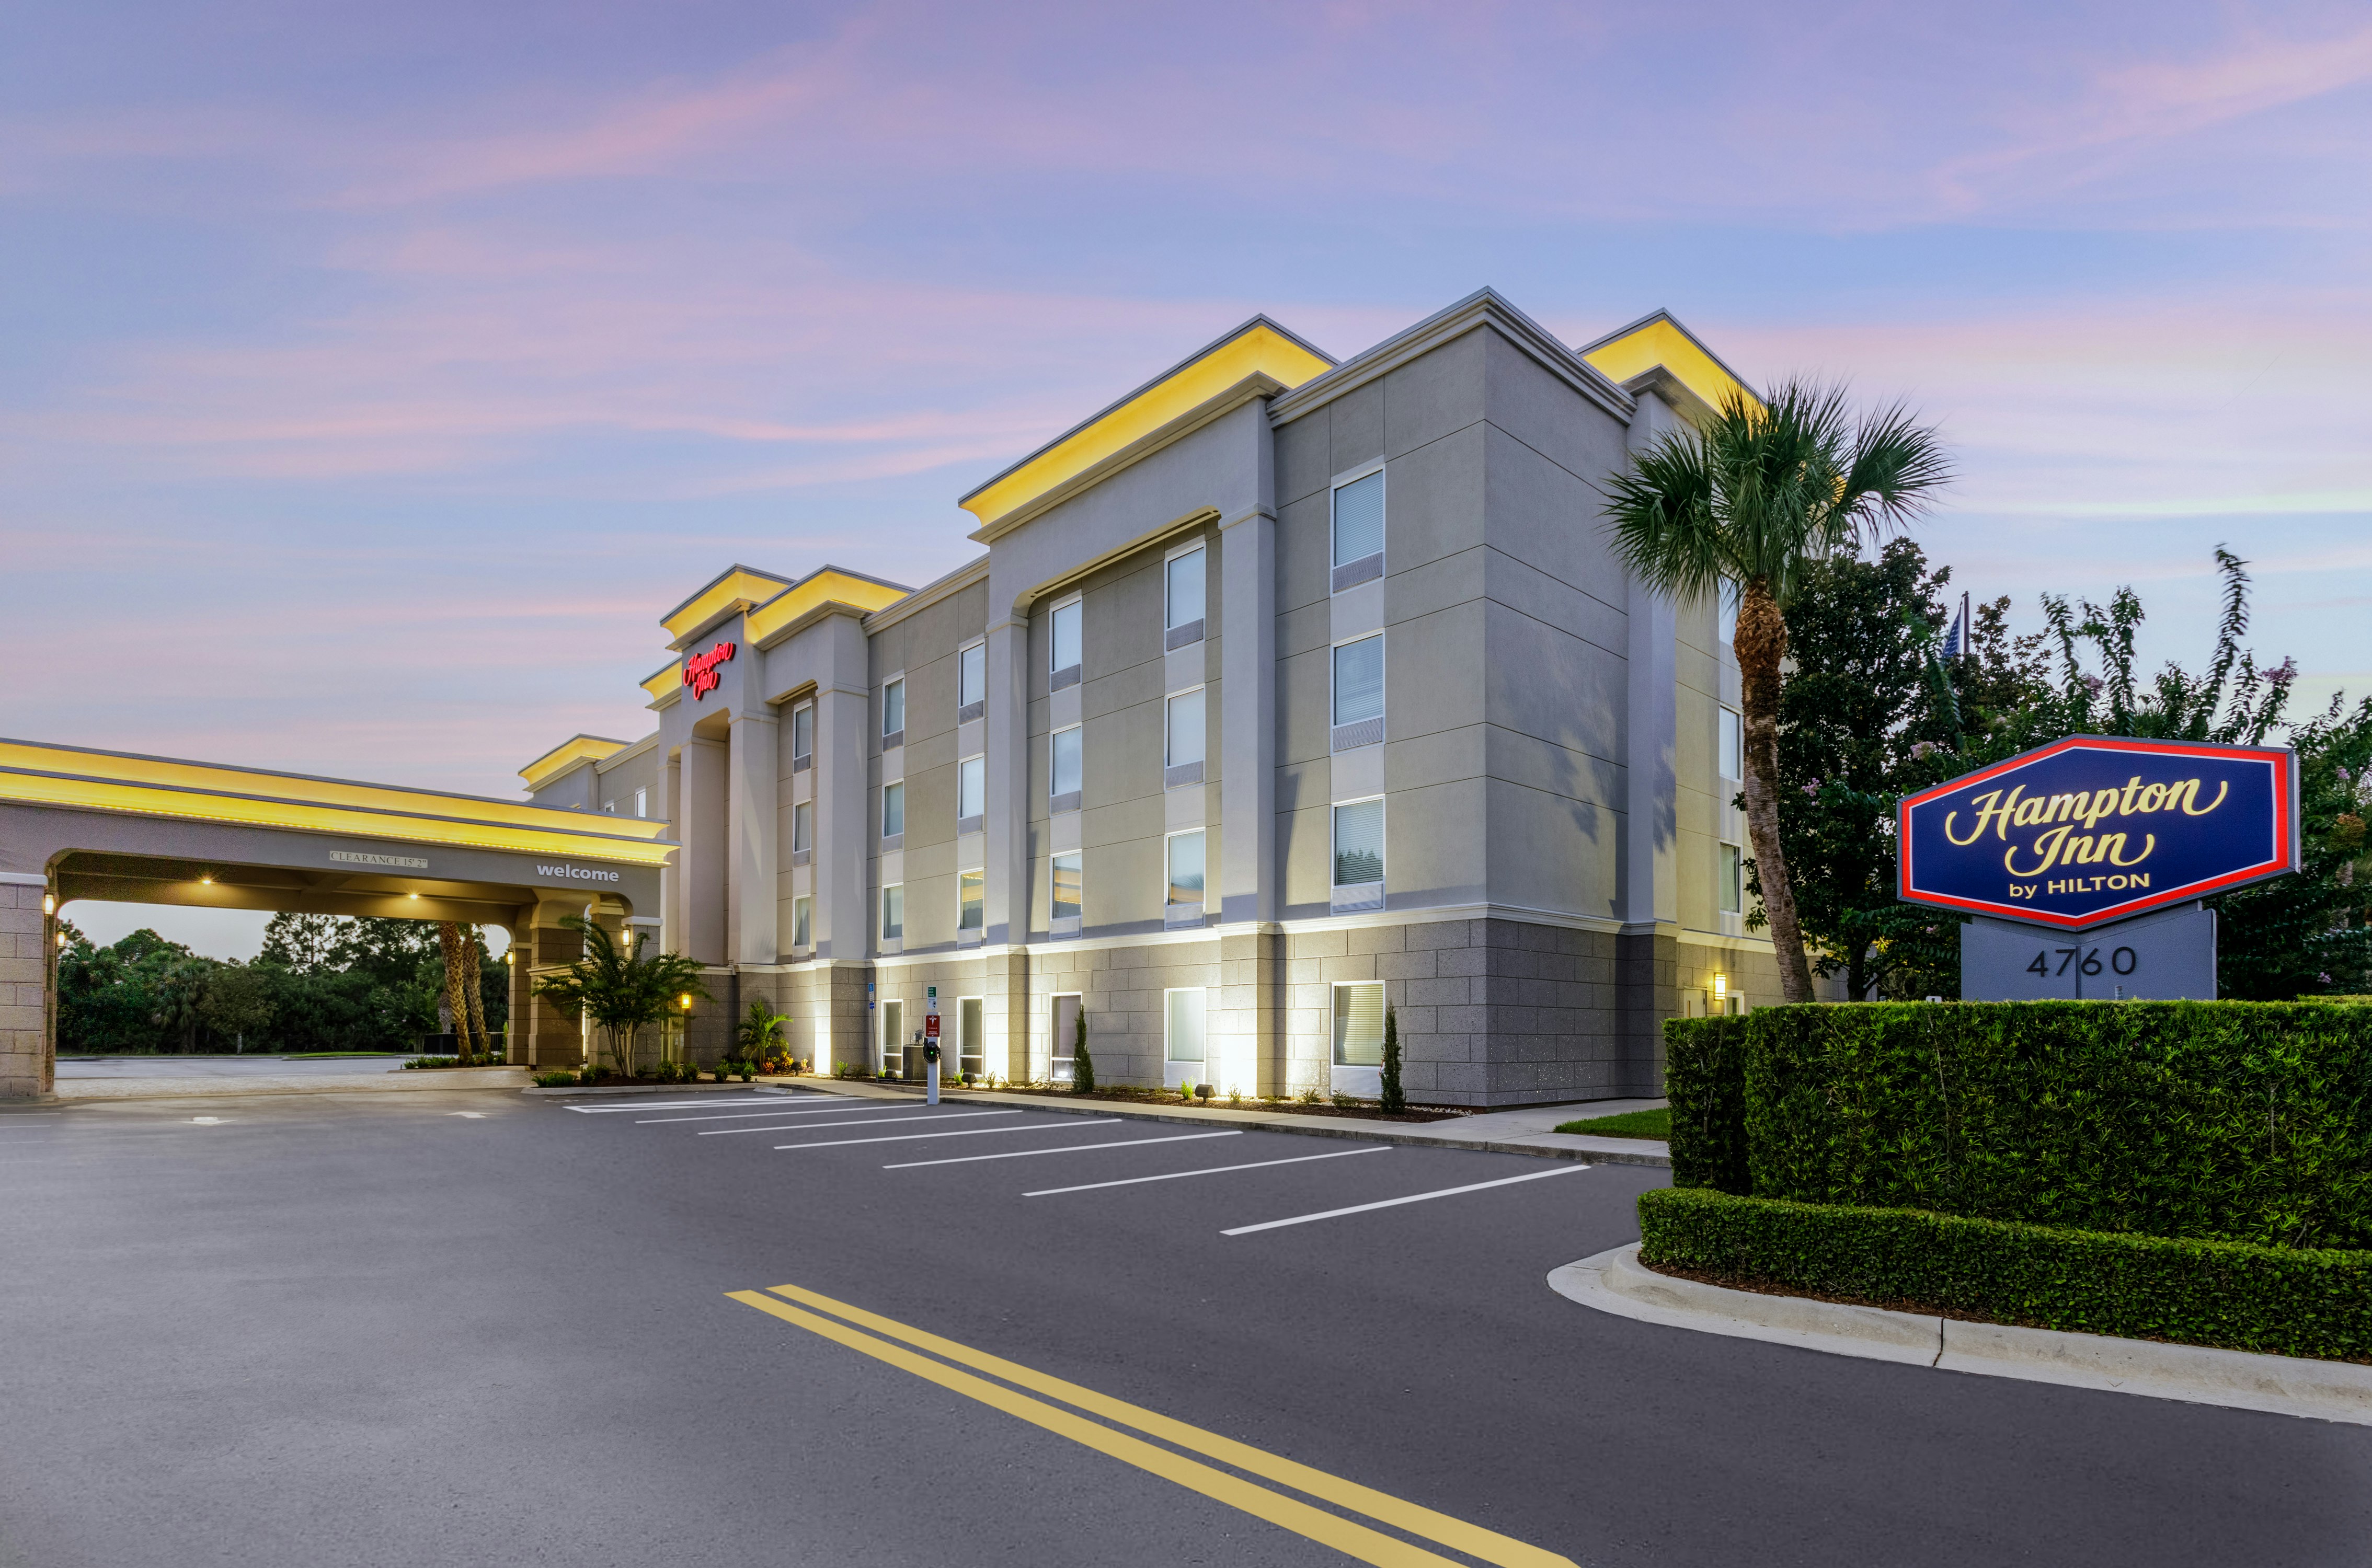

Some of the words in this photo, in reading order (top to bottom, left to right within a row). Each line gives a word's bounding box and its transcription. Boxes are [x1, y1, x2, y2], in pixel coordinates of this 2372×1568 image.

[683, 642, 734, 686] Hampton
[693, 670, 718, 700] Inn
[1945, 776, 2228, 846] Hampton
[331, 852, 400, 866] CLEARANCE
[2004, 824, 2155, 877] Inn
[536, 864, 619, 882] welcome
[2010, 883, 2037, 899] by
[2048, 873, 2150, 894] HILTON
[2026, 946, 2136, 977] 4760
